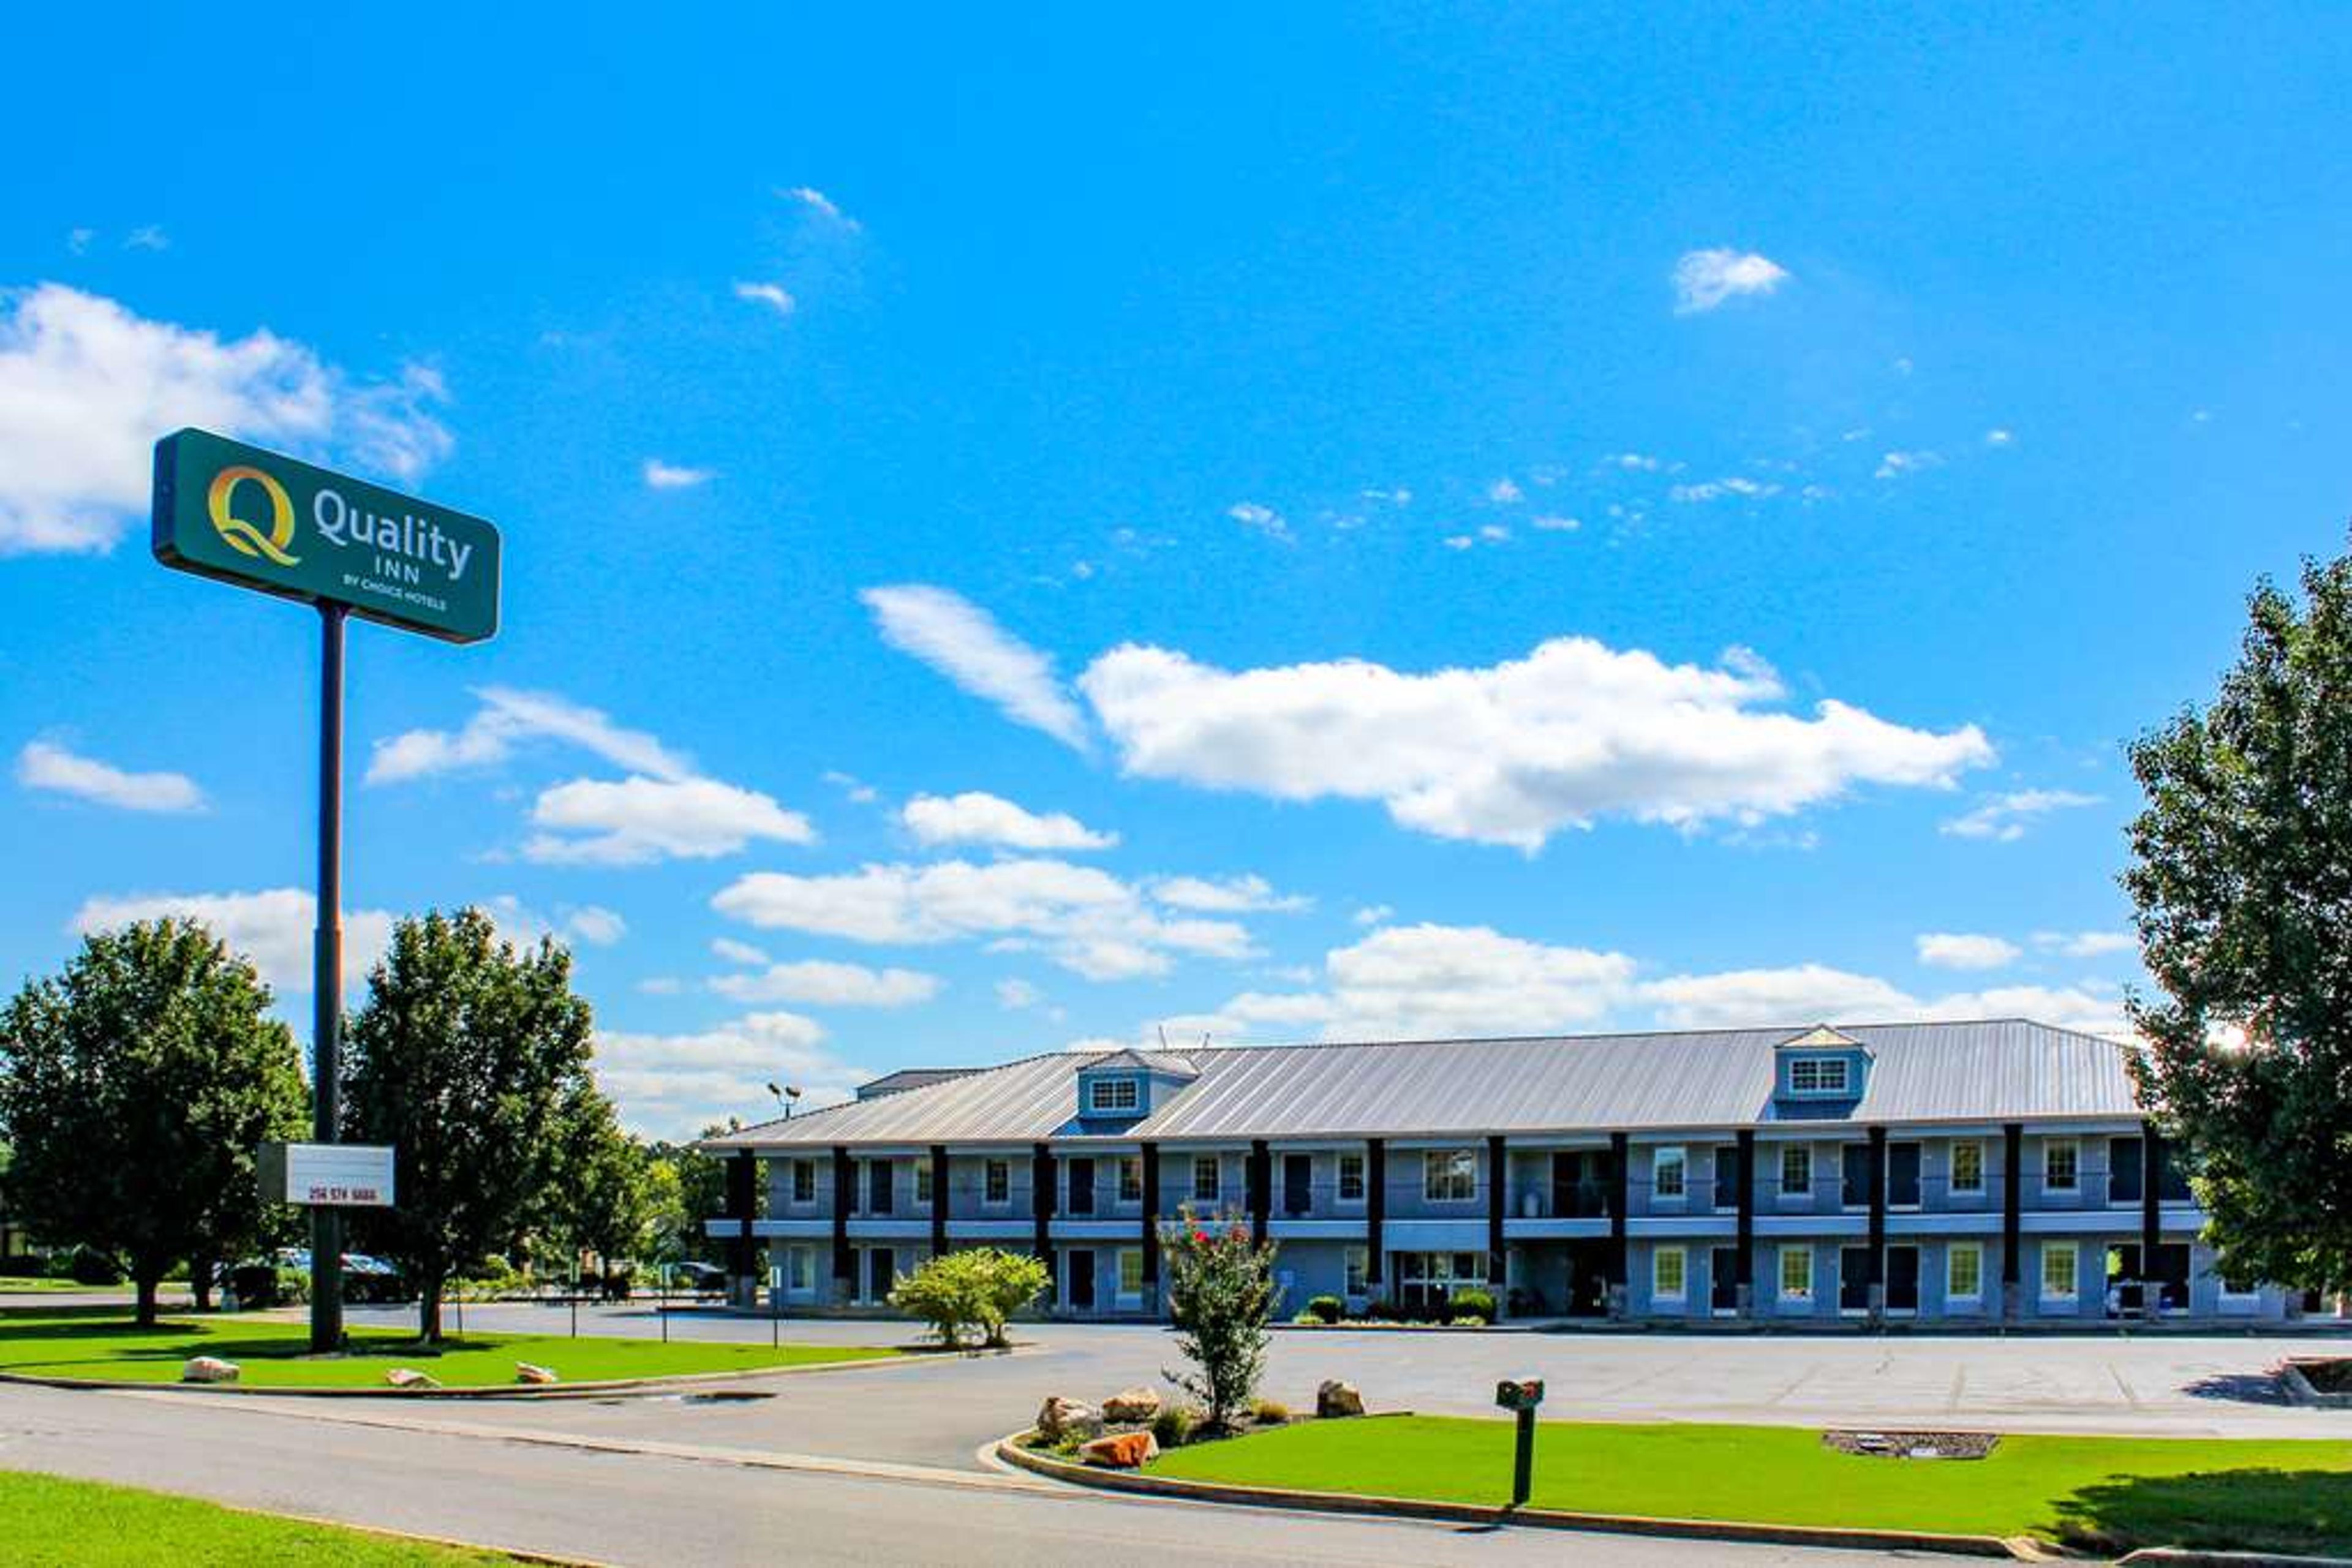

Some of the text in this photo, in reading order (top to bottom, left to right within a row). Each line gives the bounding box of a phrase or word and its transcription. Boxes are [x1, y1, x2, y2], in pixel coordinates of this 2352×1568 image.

[209, 466, 301, 567] Q
[314, 489, 472, 580] Quality
[342, 573, 360, 586] BY
[375, 554, 420, 585] INN
